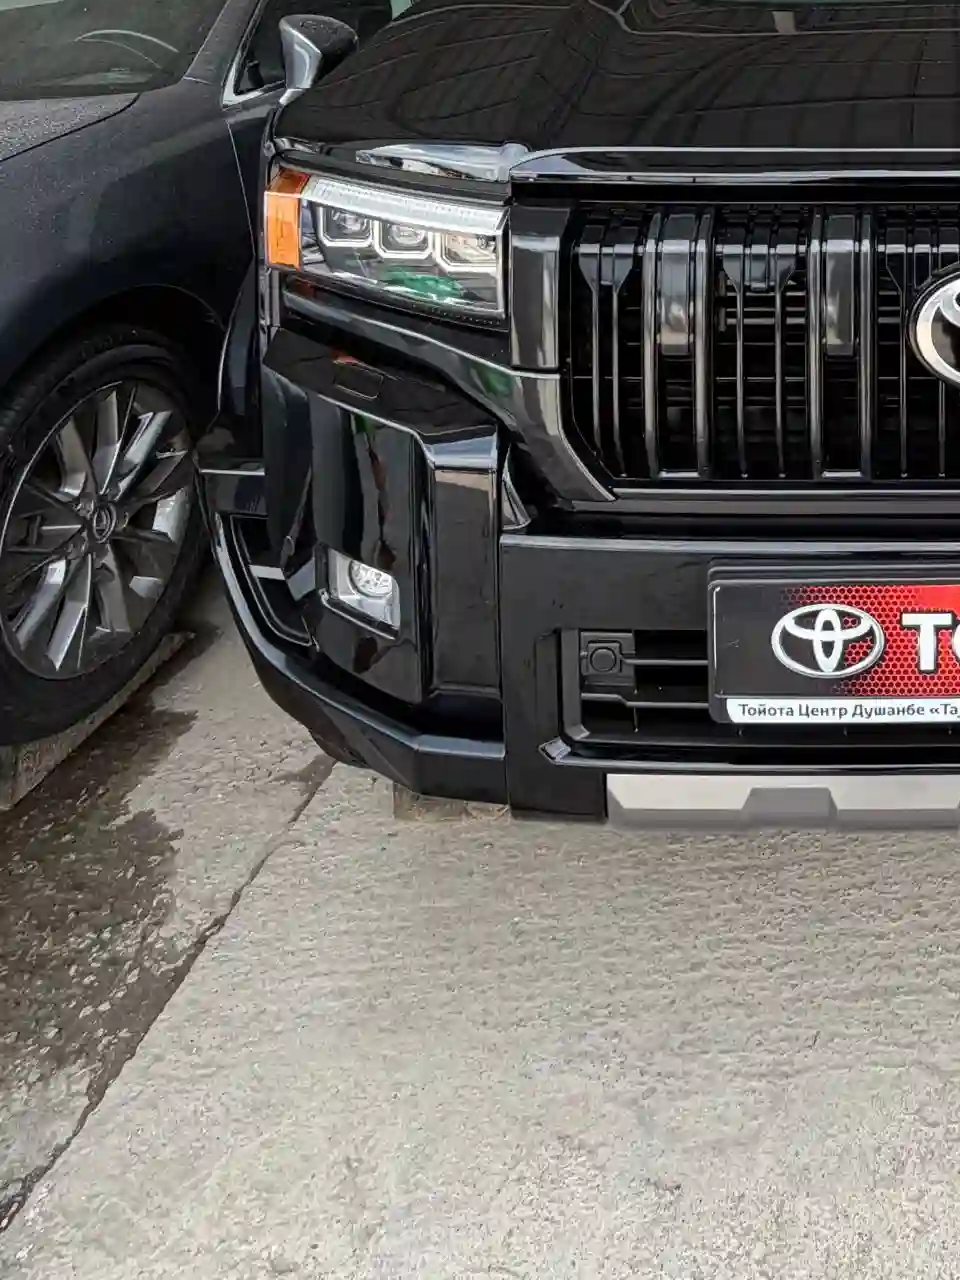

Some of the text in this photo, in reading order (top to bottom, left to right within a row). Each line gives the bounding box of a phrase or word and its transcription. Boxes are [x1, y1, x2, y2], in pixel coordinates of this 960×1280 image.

[738, 703, 795, 717] Тойота
[798, 704, 848, 720] Центр
[852, 702, 925, 719] Душанбе
